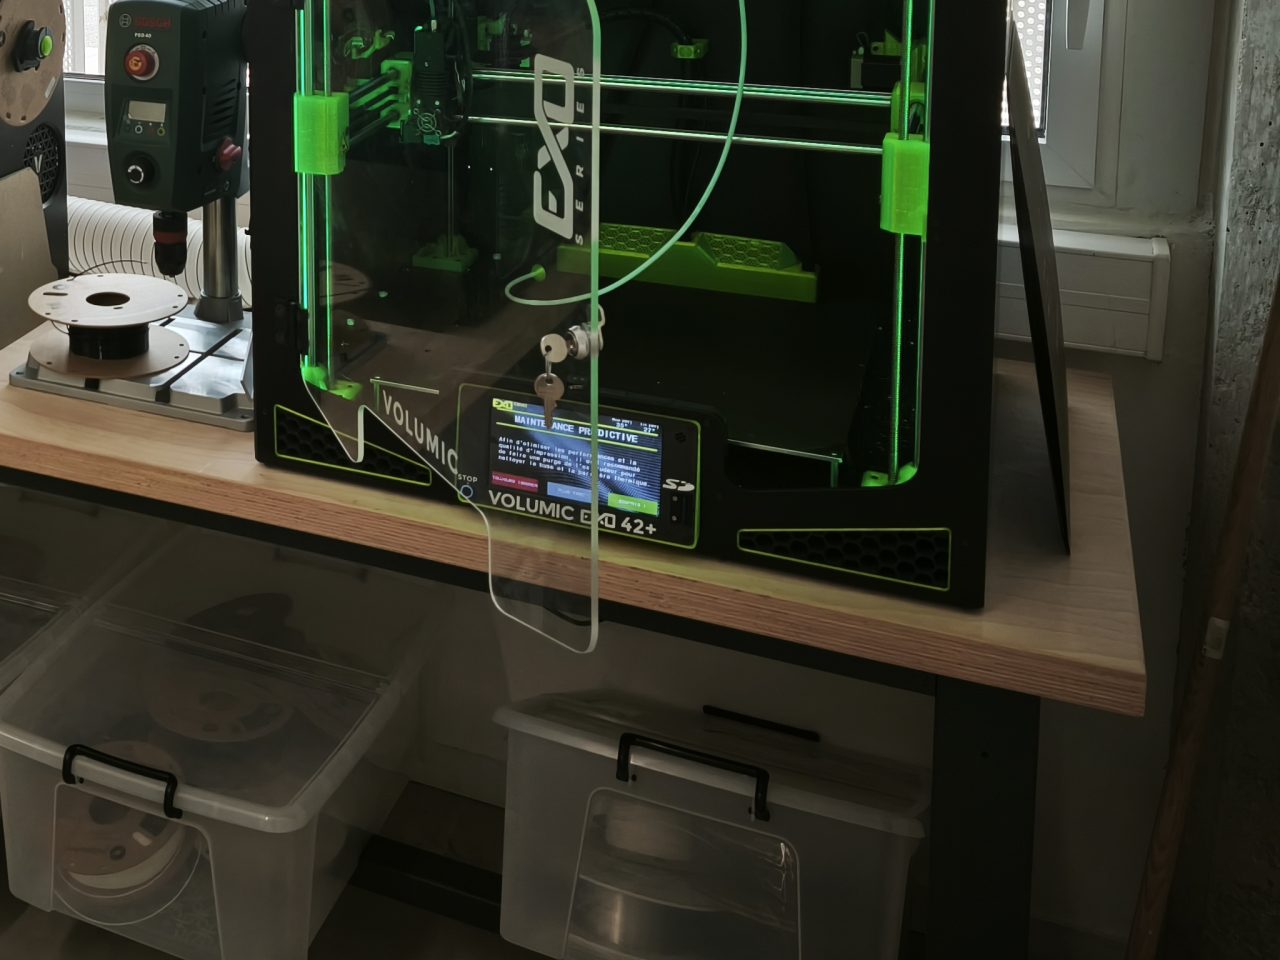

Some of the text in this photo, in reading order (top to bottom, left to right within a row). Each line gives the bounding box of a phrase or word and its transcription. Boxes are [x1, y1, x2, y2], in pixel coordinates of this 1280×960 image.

[533, 53, 574, 240] EXO
[575, 66, 585, 246] SERIES
[382, 389, 458, 475] VOLUMIC
[514, 414, 639, 443] MAINTEANCE PRDICTIVE
[457, 473, 478, 483] STOP
[488, 489, 575, 521] VOLUMIC
[621, 517, 657, 535] 42+
